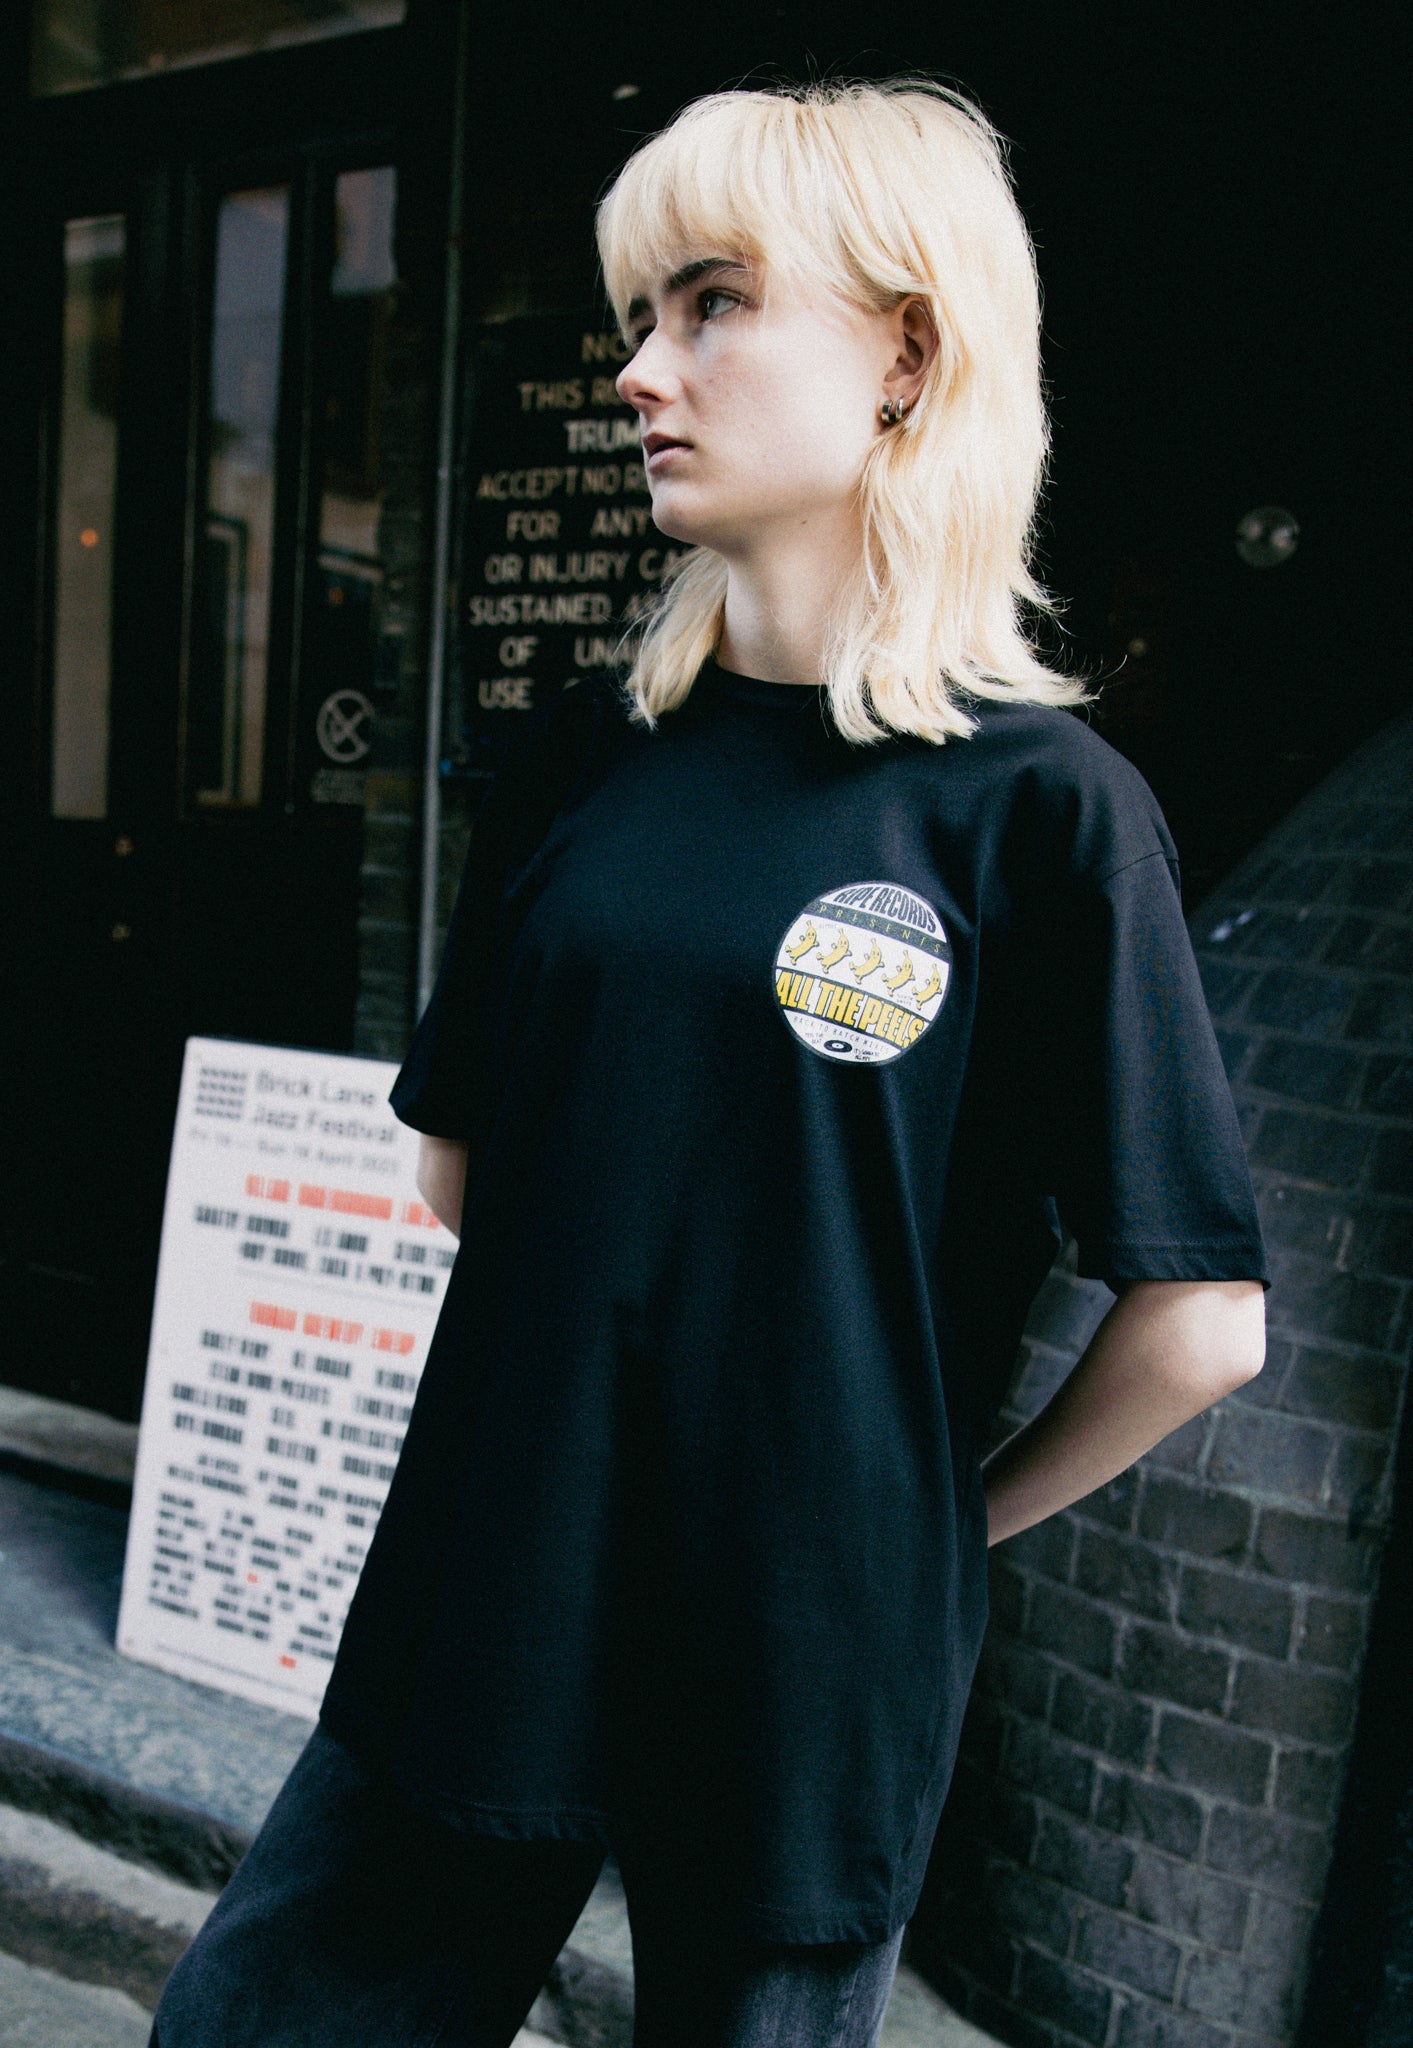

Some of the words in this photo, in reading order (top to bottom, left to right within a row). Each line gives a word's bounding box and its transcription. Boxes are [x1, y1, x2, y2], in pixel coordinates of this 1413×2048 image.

[582, 332, 634, 363] NO
[518, 379, 584, 411] THIS
[563, 418, 641, 453] TRUM
[476, 467, 577, 500] ACCEPT
[581, 463, 621, 497] NO
[506, 509, 561, 541] FOR
[590, 505, 651, 539] ANY
[484, 553, 524, 584] OR
[528, 549, 630, 583] INJURY
[469, 592, 612, 626] SUSTAINED
[499, 635, 540, 668] OF
[477, 677, 535, 710] USE
[833, 886, 877, 909] RIPE
[868, 887, 937, 934] RECORDS
[818, 904, 942, 954] PRESENTS
[776, 970, 815, 1011] ALL
[814, 979, 865, 1027] THE
[858, 994, 925, 1048] PEELS
[820, 1023, 829, 1032] TO
[319, 1078, 377, 1108] Lane
[306, 1107, 398, 1143] Festival
